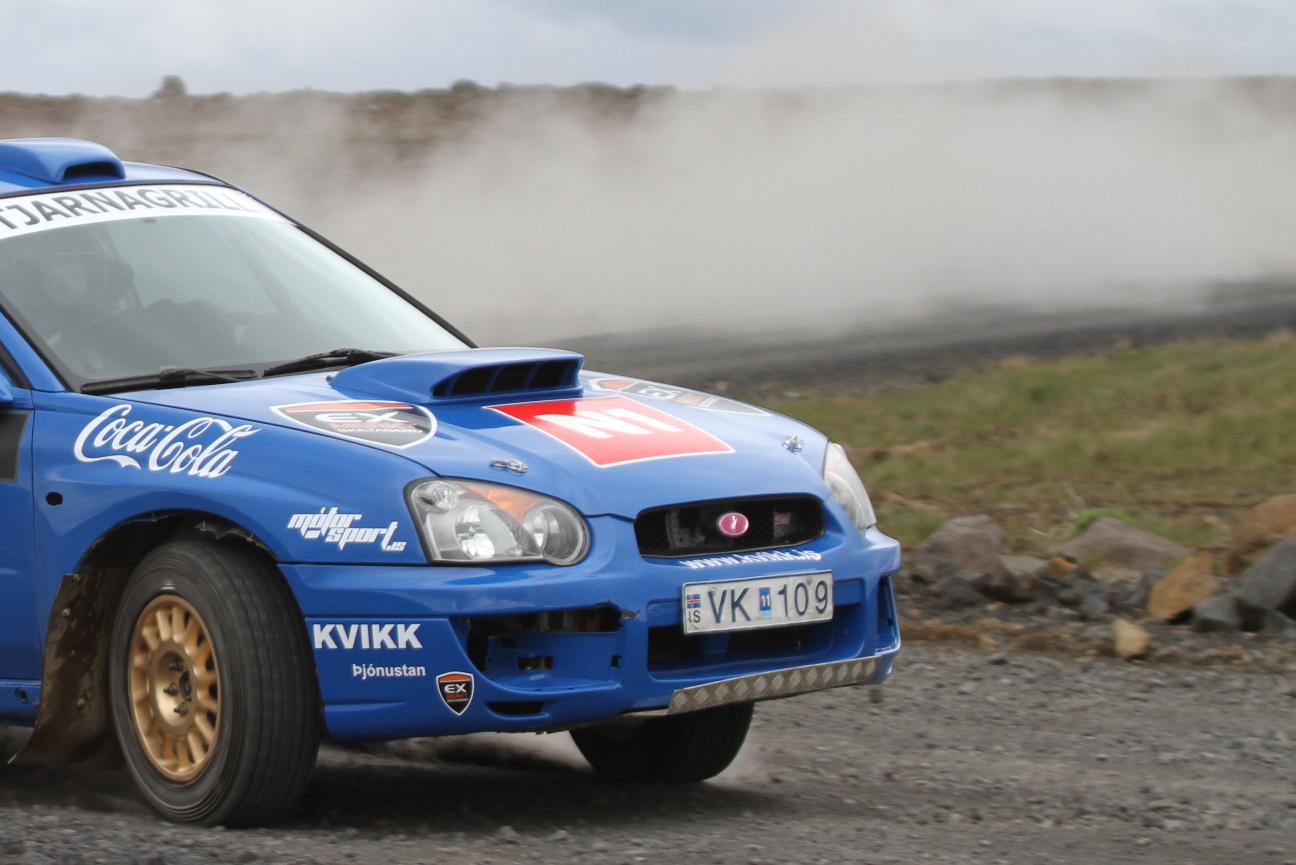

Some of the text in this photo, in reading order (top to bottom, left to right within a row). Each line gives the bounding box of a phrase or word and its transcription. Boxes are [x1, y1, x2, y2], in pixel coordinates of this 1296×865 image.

[314, 411, 410, 423] EX
[533, 407, 684, 439] N1
[74, 403, 263, 478] Coca-Cola
[678, 549, 822, 569] www.kvikk.is
[707, 579, 829, 624] VK 109
[760, 595, 771, 607] 11
[312, 623, 424, 649] KVIKK
[352, 663, 426, 680] Þjónustan
[444, 683, 467, 693] EX
